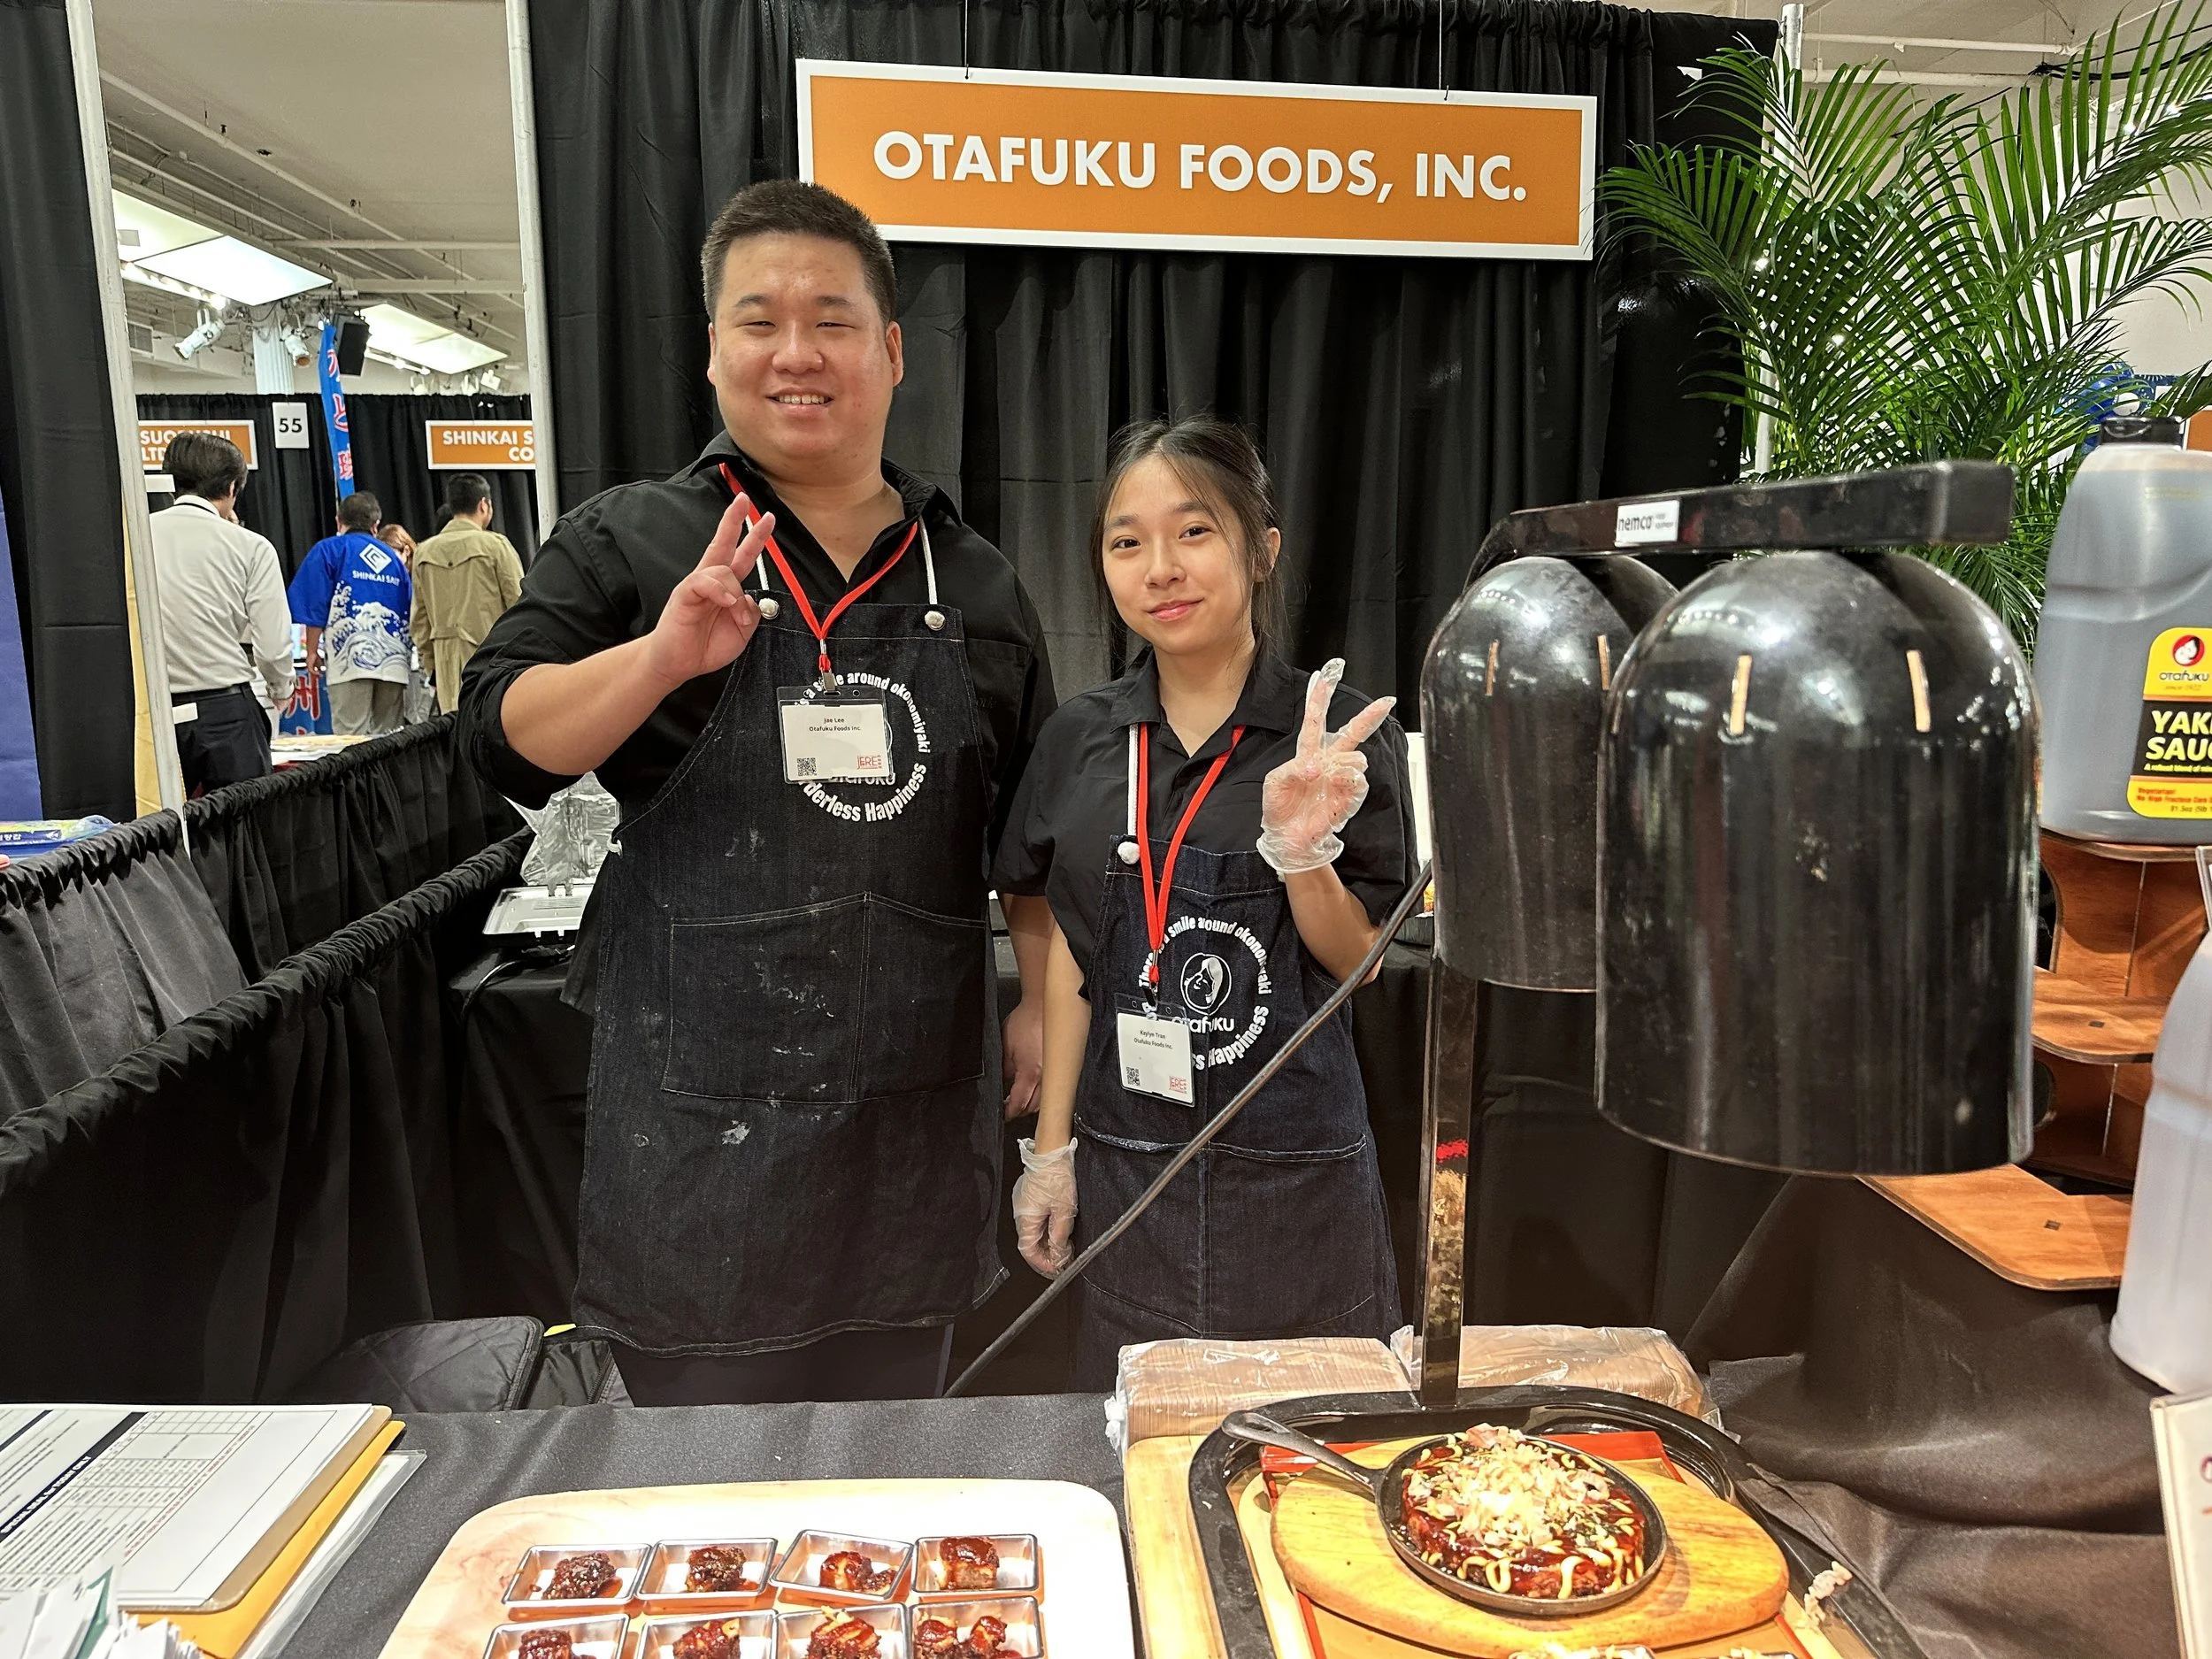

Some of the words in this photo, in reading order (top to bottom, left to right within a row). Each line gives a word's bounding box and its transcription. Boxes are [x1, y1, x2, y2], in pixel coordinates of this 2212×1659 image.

[872, 130, 1156, 190] OTAFUKU
[1180, 143, 1394, 204] FOODS,
[1416, 153, 1528, 202] INC.
[279, 419, 303, 434] 55
[442, 430, 518, 445] SHINKAI
[1618, 515, 1652, 531] nemco
[352, 570, 385, 583] SHINKAI
[847, 672, 890, 690] around
[890, 683, 931, 753] okonomiyaki
[2151, 710, 2212, 735] YAK
[798, 780, 862, 822] derless
[864, 763, 927, 822] Happiness
[1168, 916, 1196, 938] smile
[1234, 926, 1272, 995] okonoaki
[1208, 1005, 1270, 1067] Happiness
